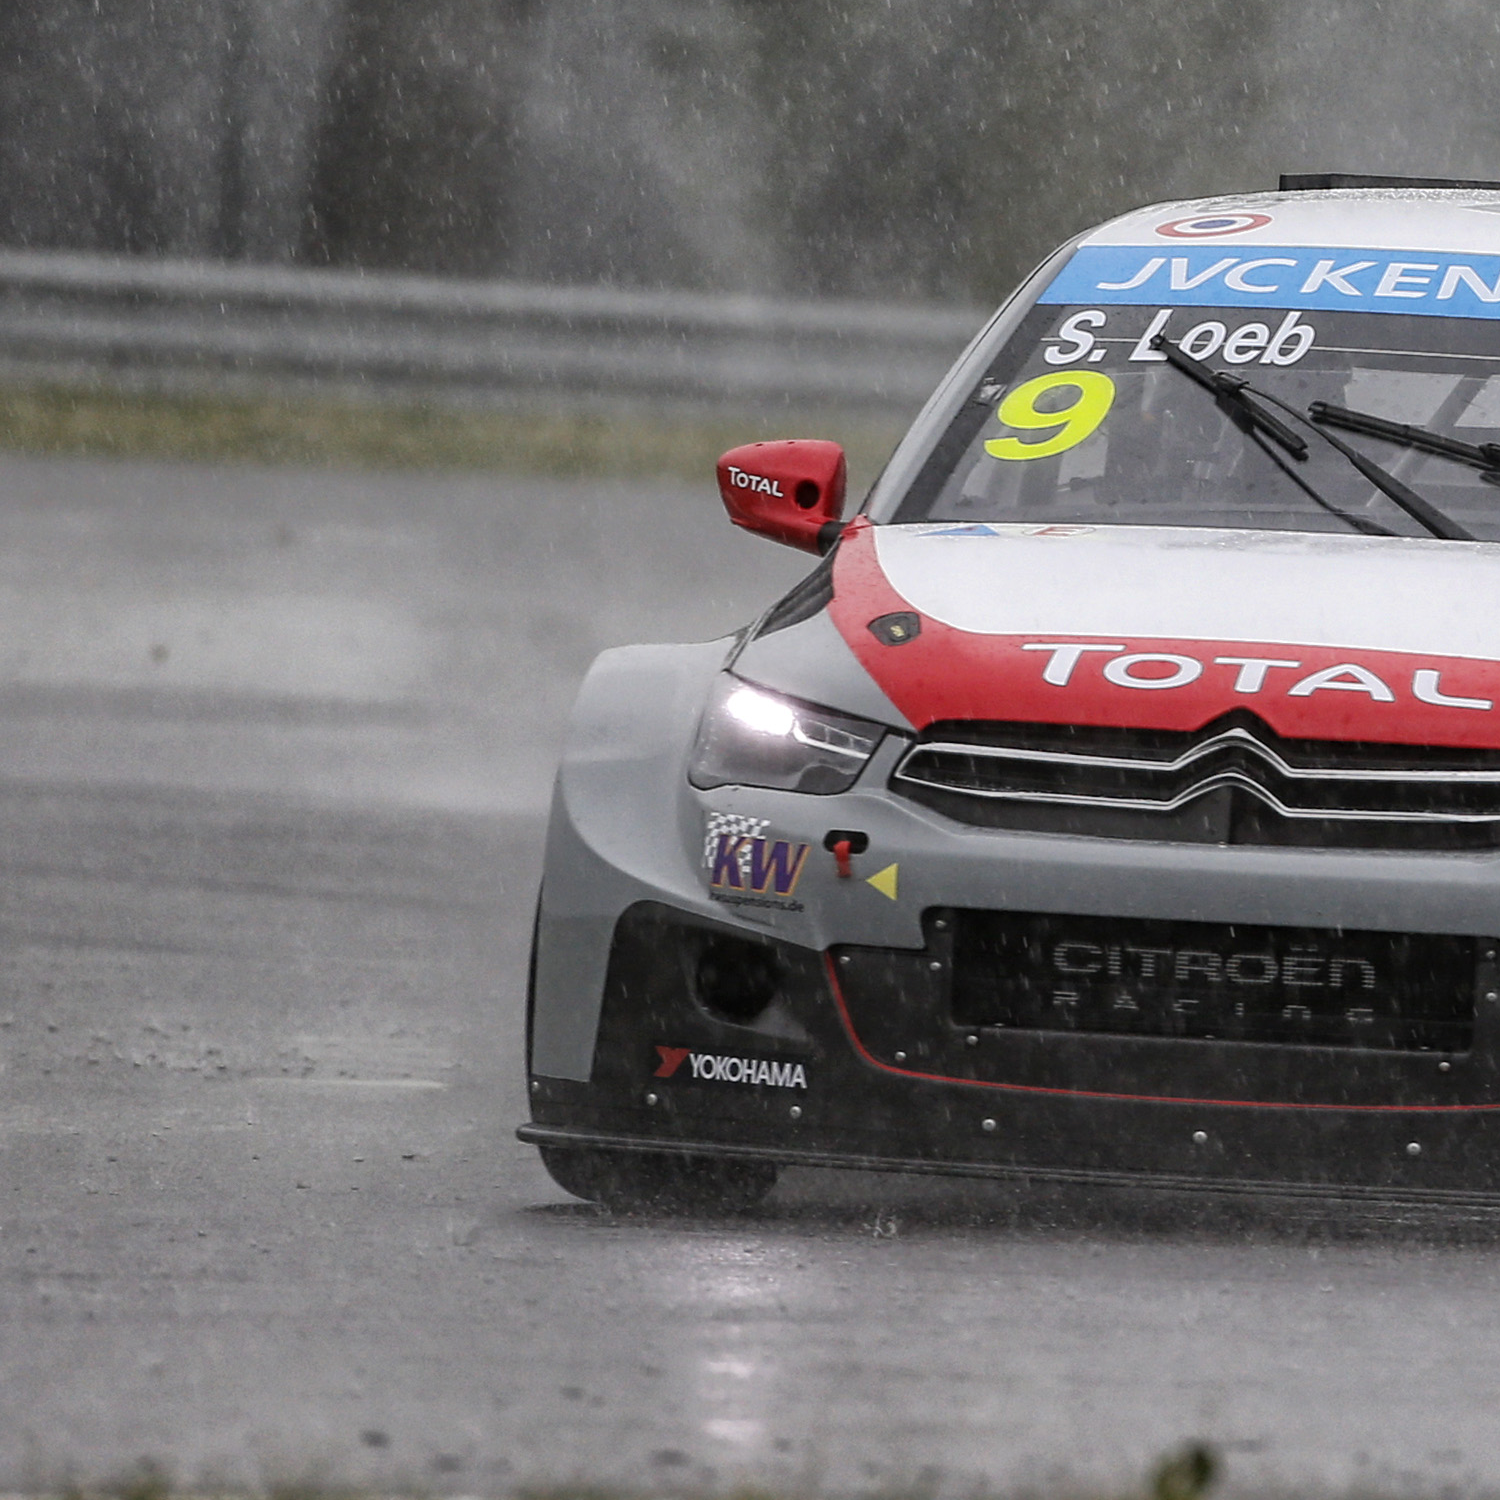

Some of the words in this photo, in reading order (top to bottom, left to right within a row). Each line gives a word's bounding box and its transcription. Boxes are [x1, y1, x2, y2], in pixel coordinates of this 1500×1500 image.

[1043, 309, 1107, 365] S.
[1128, 308, 1316, 366] Loeb
[984, 369, 1117, 461] 9
[728, 466, 784, 498] TOTAL
[1021, 642, 1494, 711] TOTAL
[711, 833, 812, 896] KW
[688, 1052, 808, 1089] YOKOHAMA
